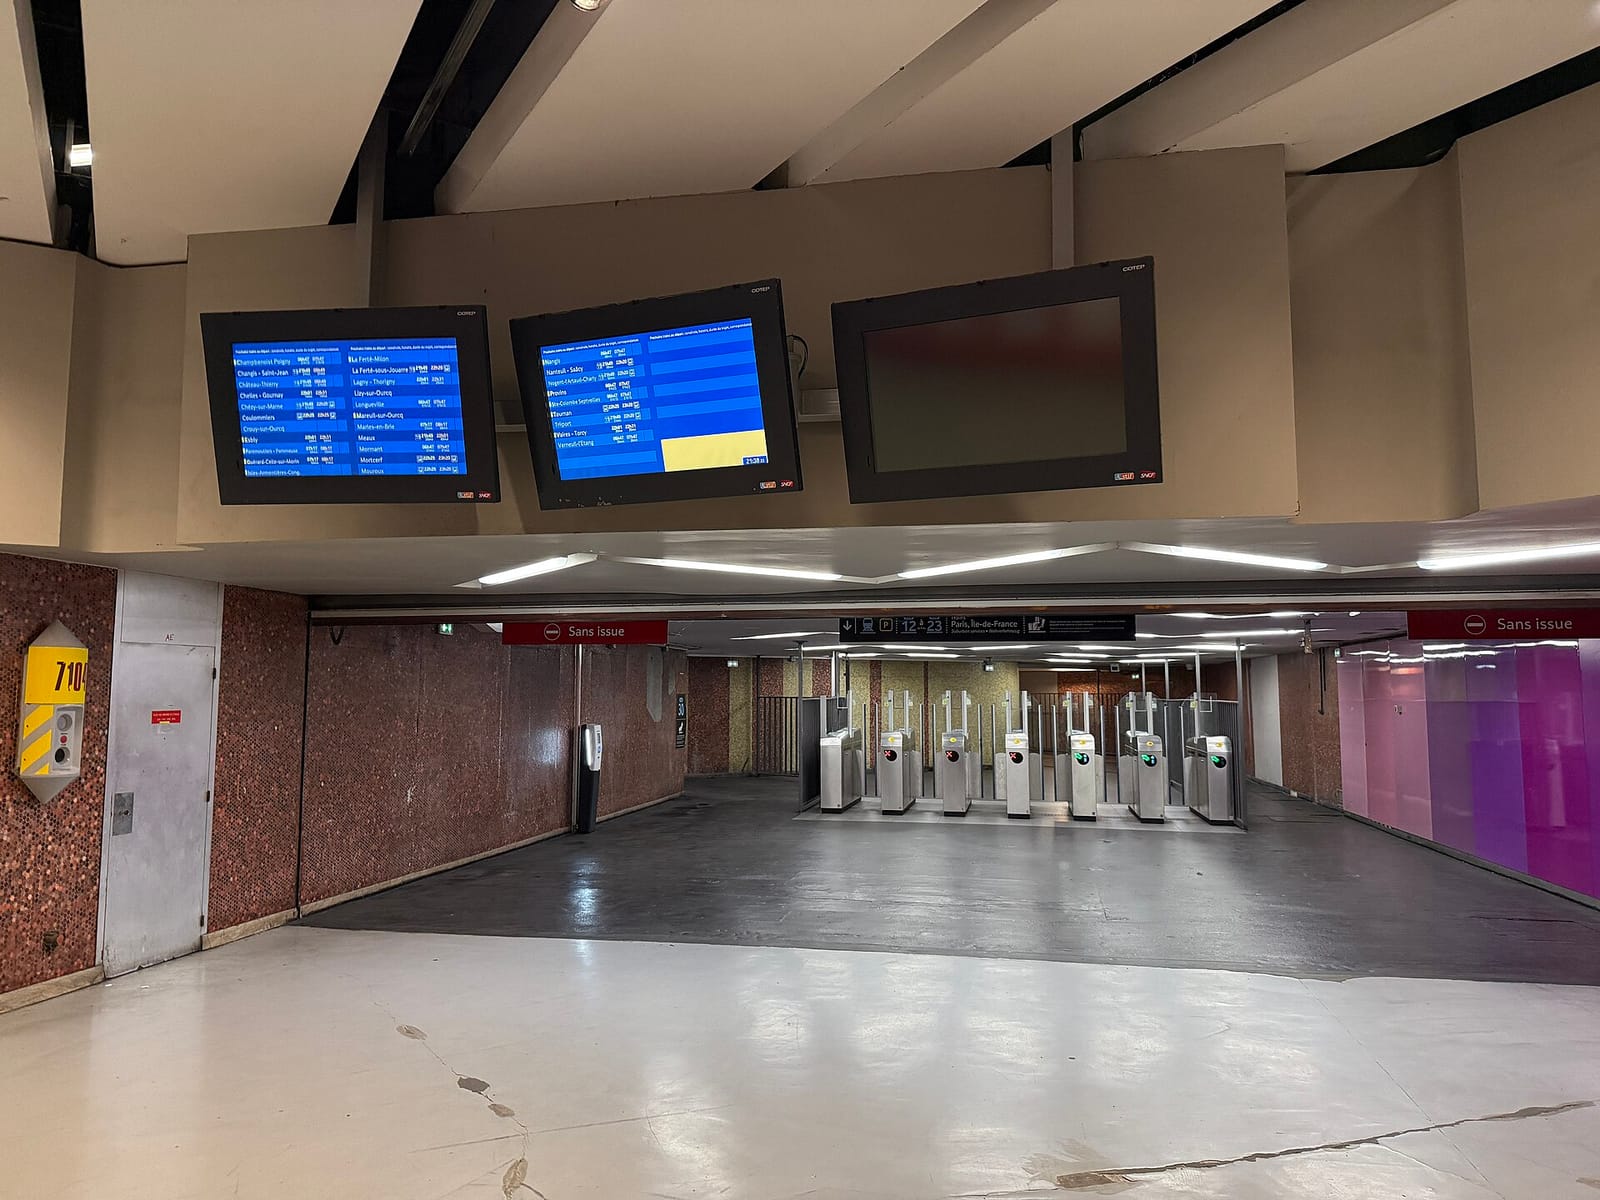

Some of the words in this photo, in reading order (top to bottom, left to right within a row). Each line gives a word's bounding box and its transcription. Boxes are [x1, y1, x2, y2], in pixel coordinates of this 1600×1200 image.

[902, 621, 917, 632] 12
[926, 620, 943, 631] 23
[971, 619, 1018, 628] Île-de-France
[1498, 618, 1531, 630] Sans
[1536, 618, 1572, 630] issue
[568, 626, 594, 637] Sans
[597, 626, 624, 637] issue
